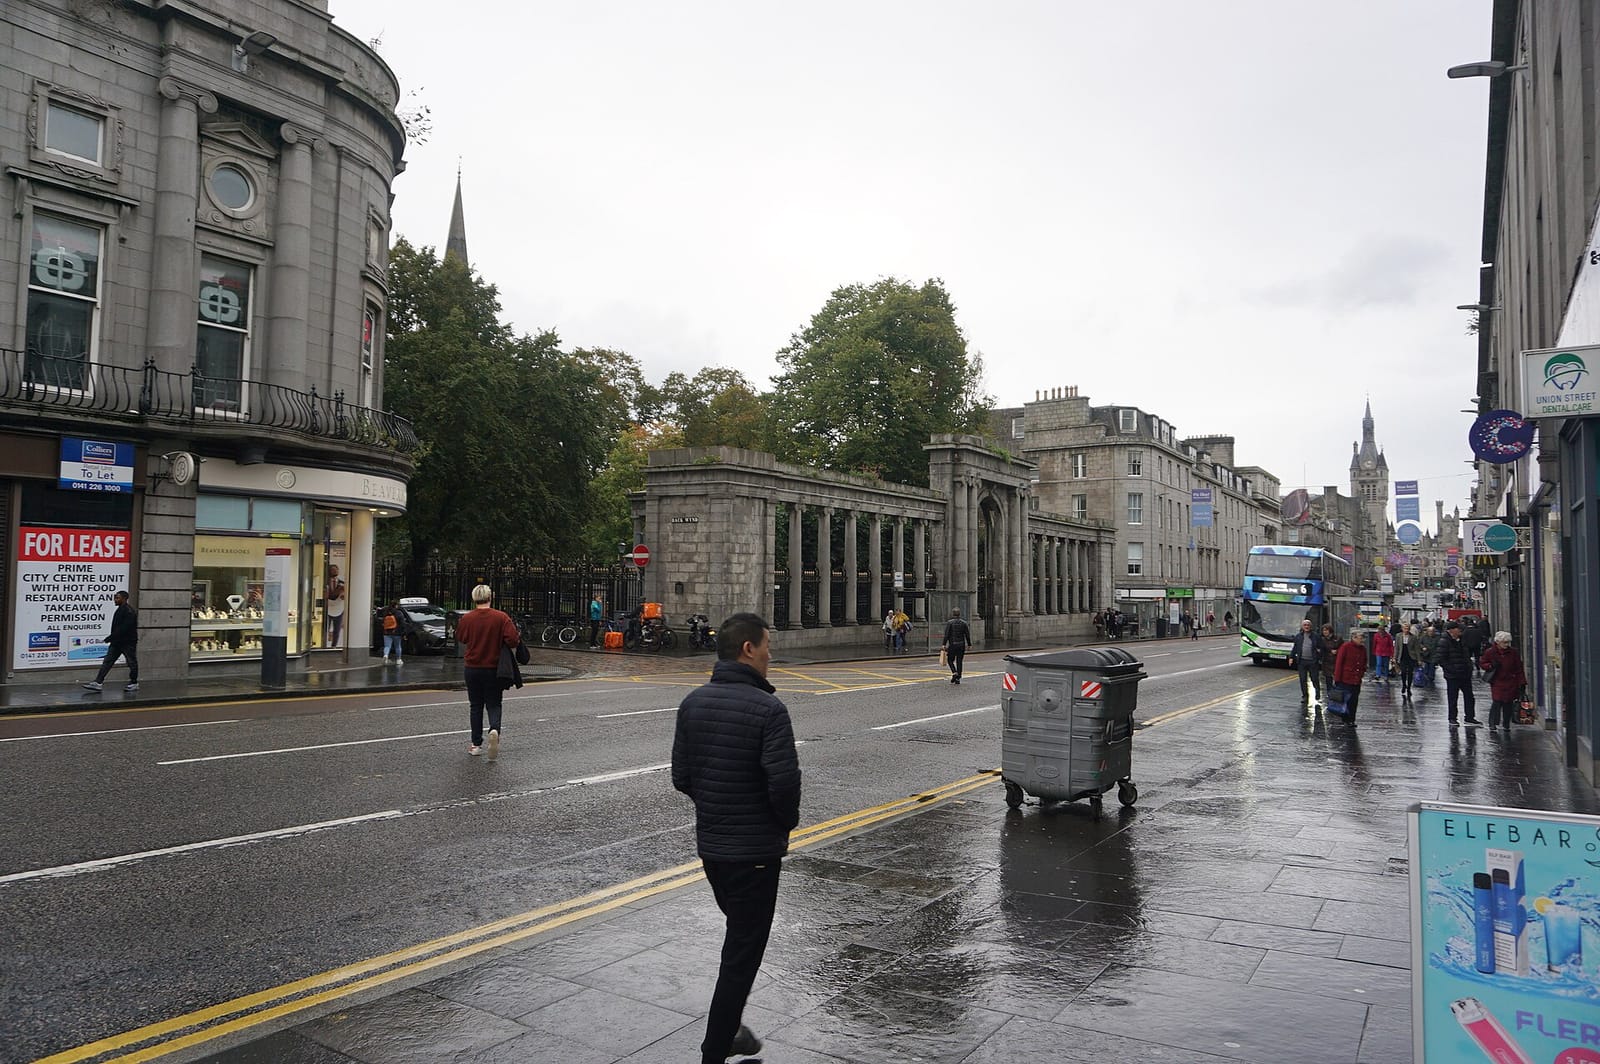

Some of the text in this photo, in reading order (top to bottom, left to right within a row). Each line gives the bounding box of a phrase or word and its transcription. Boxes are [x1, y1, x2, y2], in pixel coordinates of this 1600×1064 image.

[1536, 392, 1596, 404] UNION STREET
[1542, 402, 1593, 413] DENTAL CARE
[86, 444, 113, 454] Colliers
[81, 469, 114, 480] To Let
[25, 532, 125, 558] FOR LEASE
[57, 564, 93, 573] PRIME
[22, 573, 124, 583] CITY CENTRE UNIT
[31, 584, 116, 592] WITH HOT FOOD
[1300, 584, 1307, 594] 6
[25, 594, 114, 602] RESTAURANT AN
[44, 603, 103, 612] TAKEAWAY
[41, 613, 105, 622] PERMISSION
[31, 635, 57, 643] Colliers
